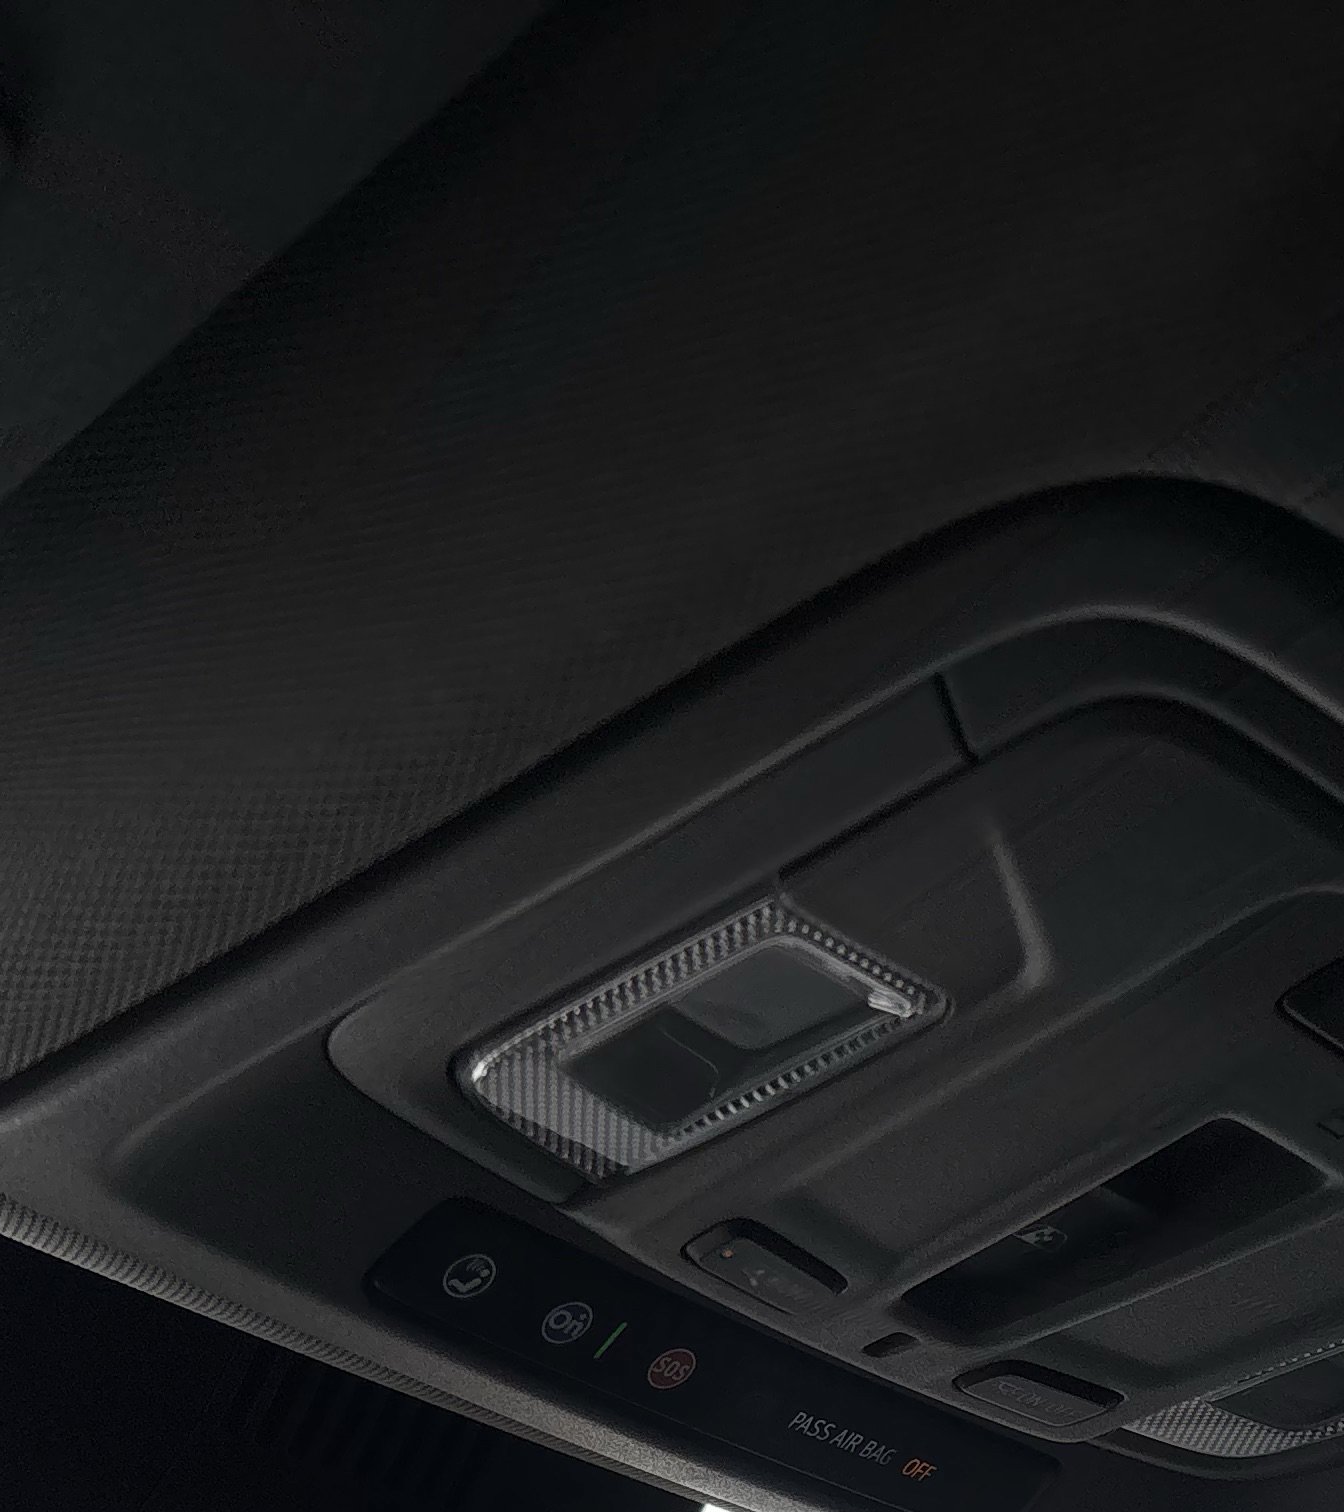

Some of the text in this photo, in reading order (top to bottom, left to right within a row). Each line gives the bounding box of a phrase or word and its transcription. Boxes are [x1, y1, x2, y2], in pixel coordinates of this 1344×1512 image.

[653, 1356, 690, 1381] SOS
[788, 1411, 938, 1481] PASS AIR BAG OFF
